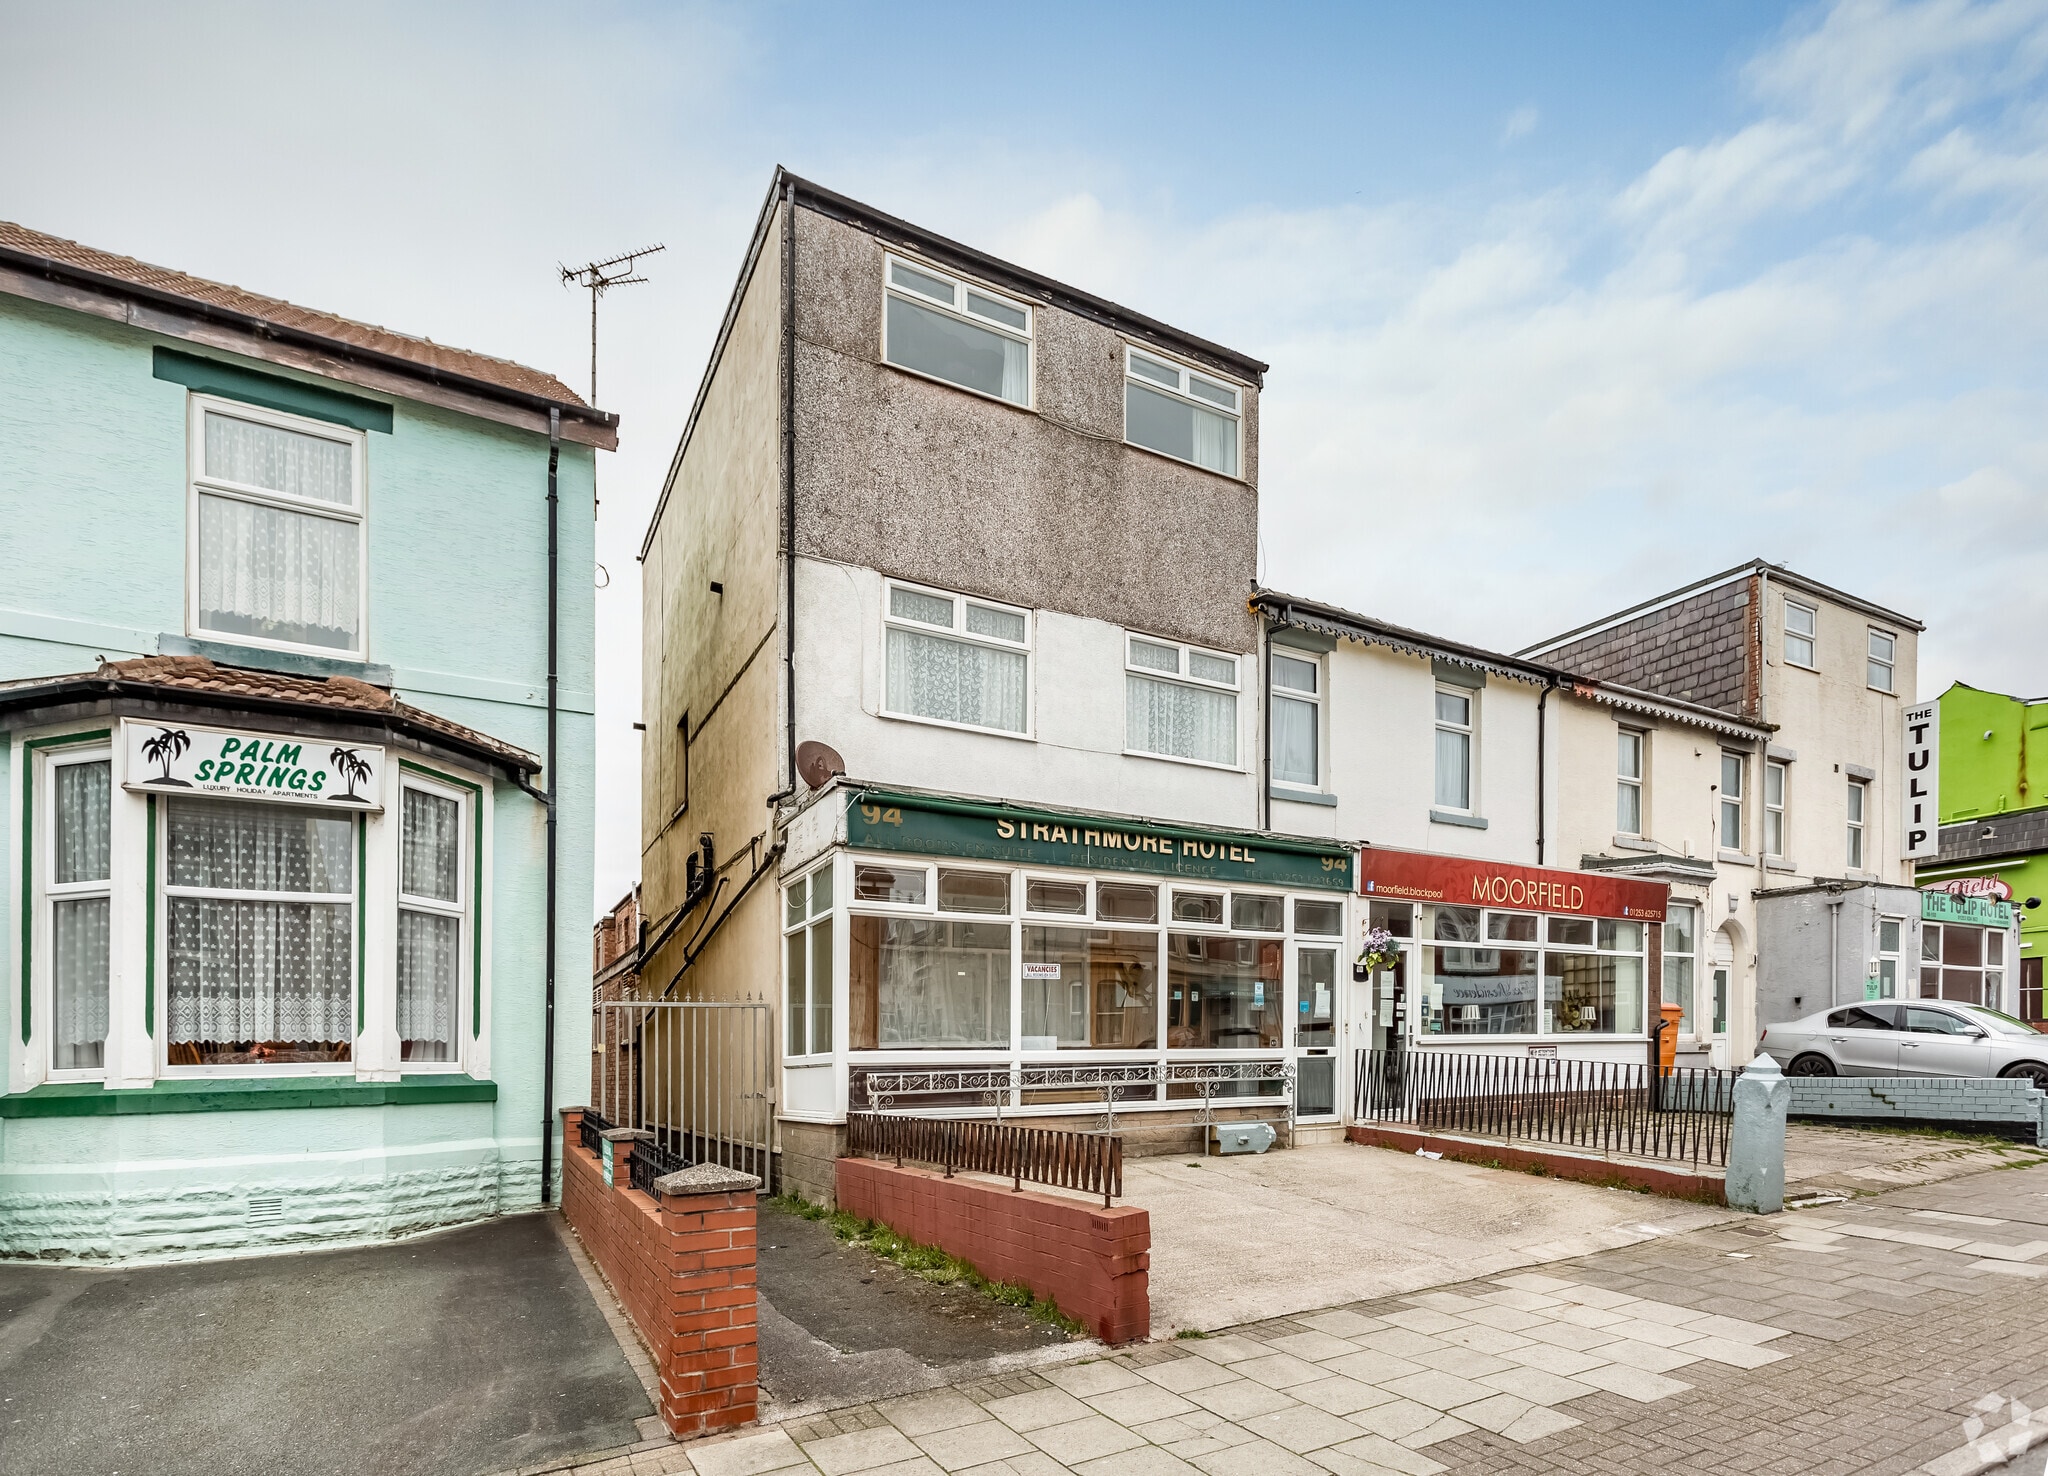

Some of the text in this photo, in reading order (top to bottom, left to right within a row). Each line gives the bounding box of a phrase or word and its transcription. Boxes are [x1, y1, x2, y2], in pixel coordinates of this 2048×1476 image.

[1906, 709, 1932, 721] THE
[220, 737, 302, 766] PALM
[194, 759, 327, 791] SPRINGS
[1908, 723, 1930, 851] TULIP
[203, 784, 318, 799] LUXURY HOLIDAY APARTMENTS
[861, 805, 904, 827] 94
[1183, 840, 1256, 863] HOTEL
[1376, 885, 1443, 899] moorfield.blackpool
[1472, 874, 1584, 910] MOORFIELD
[1926, 894, 1946, 912] THE
[1980, 901, 2009, 920] HOTEL
